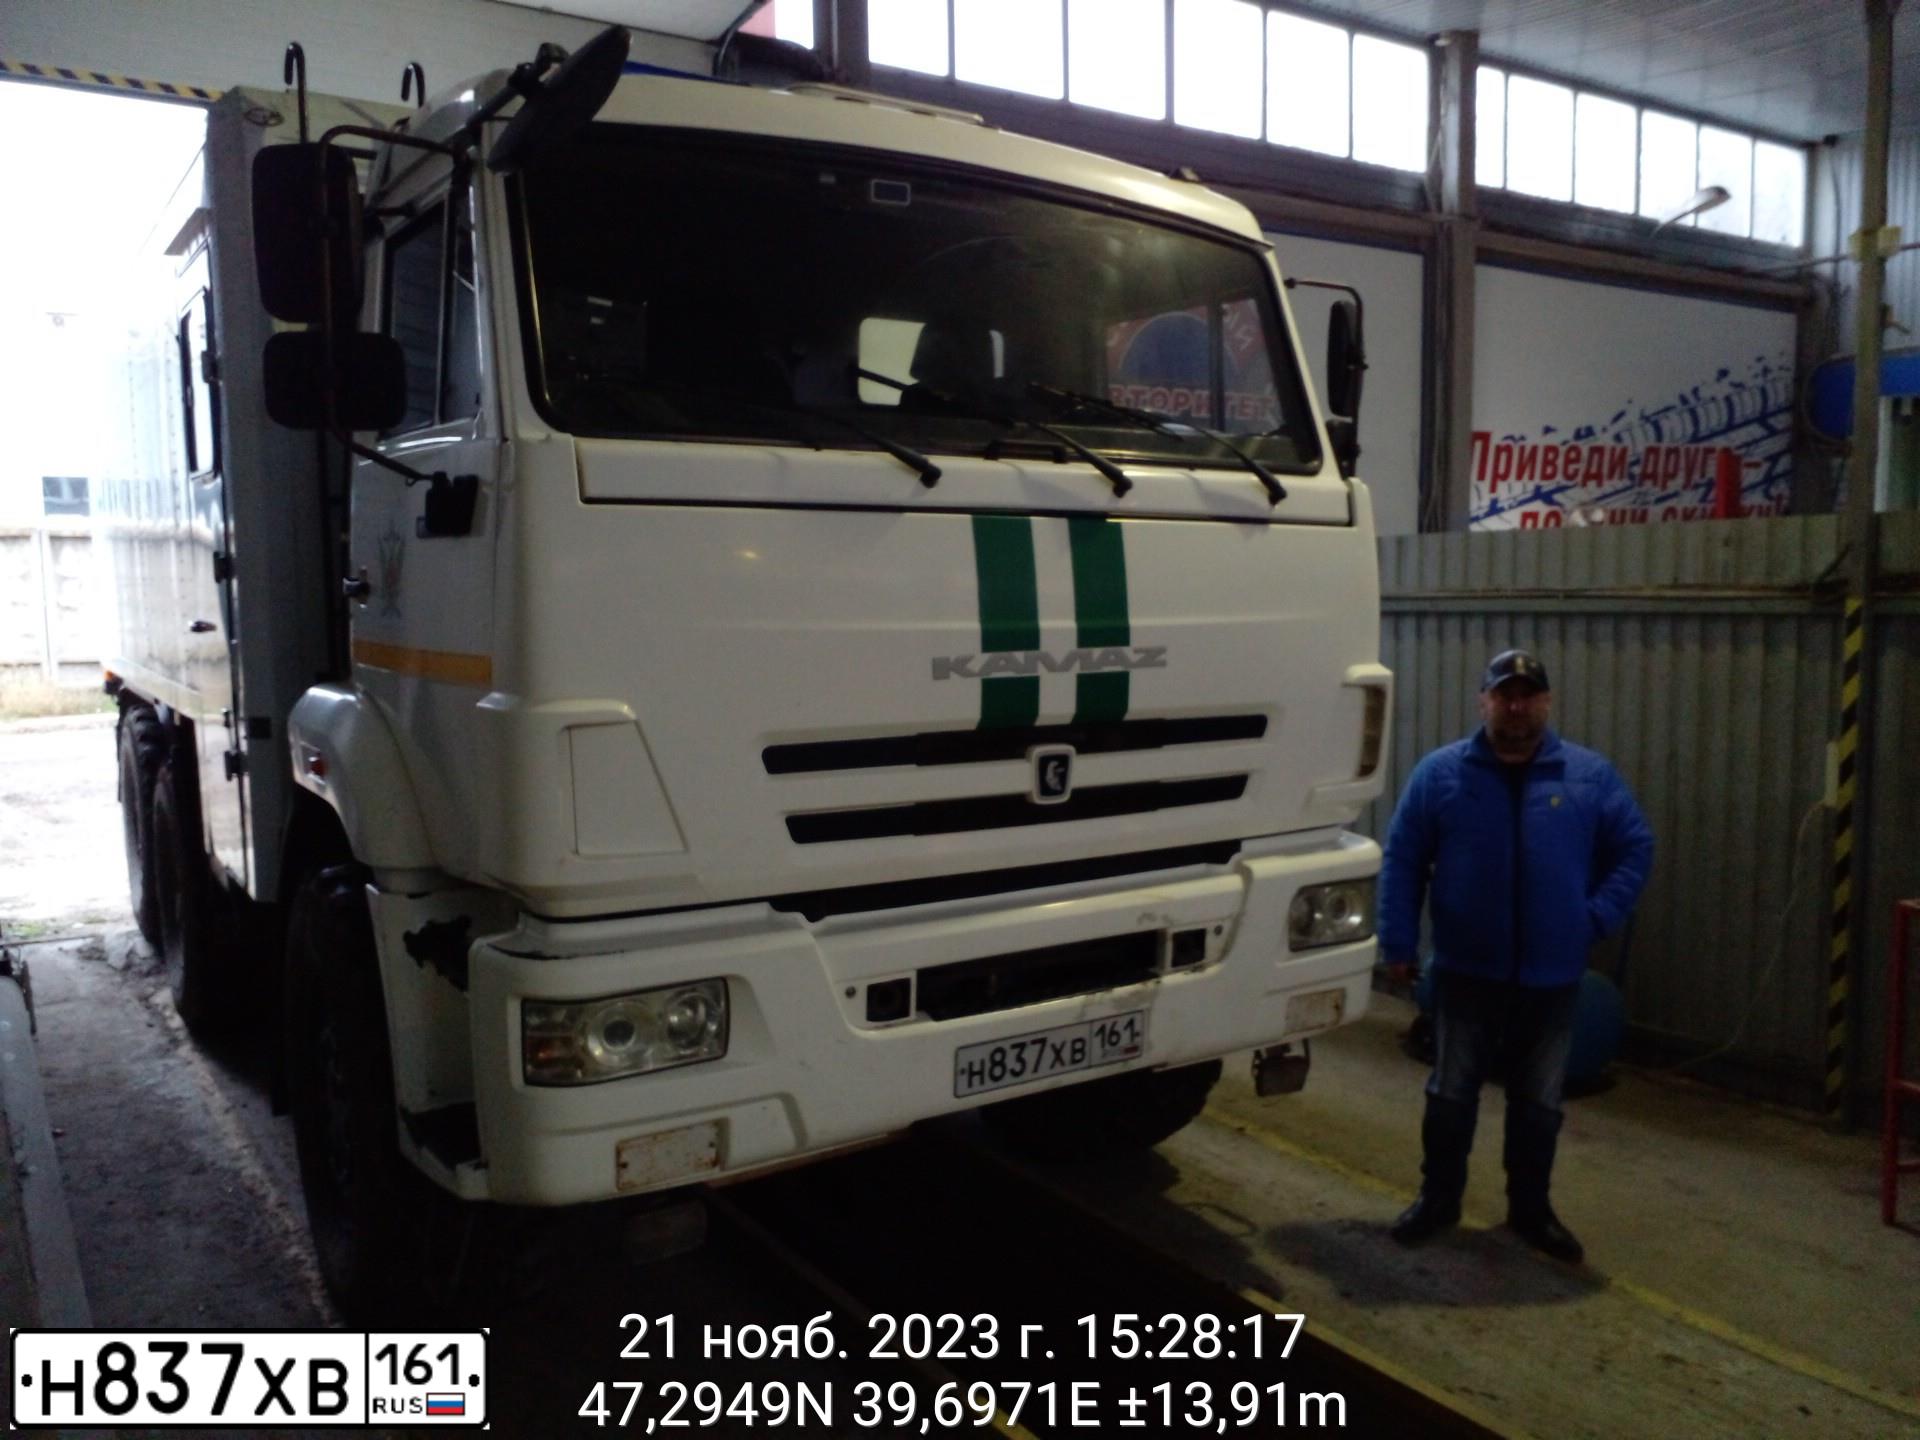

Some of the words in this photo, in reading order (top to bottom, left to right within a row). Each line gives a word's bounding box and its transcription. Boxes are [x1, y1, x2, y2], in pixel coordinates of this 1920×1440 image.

[1471, 431, 1628, 493] Приведи
[1639, 445, 1735, 492] друг
[932, 646, 1168, 681] KAMAZ
[1095, 1017, 1136, 1049] 161
